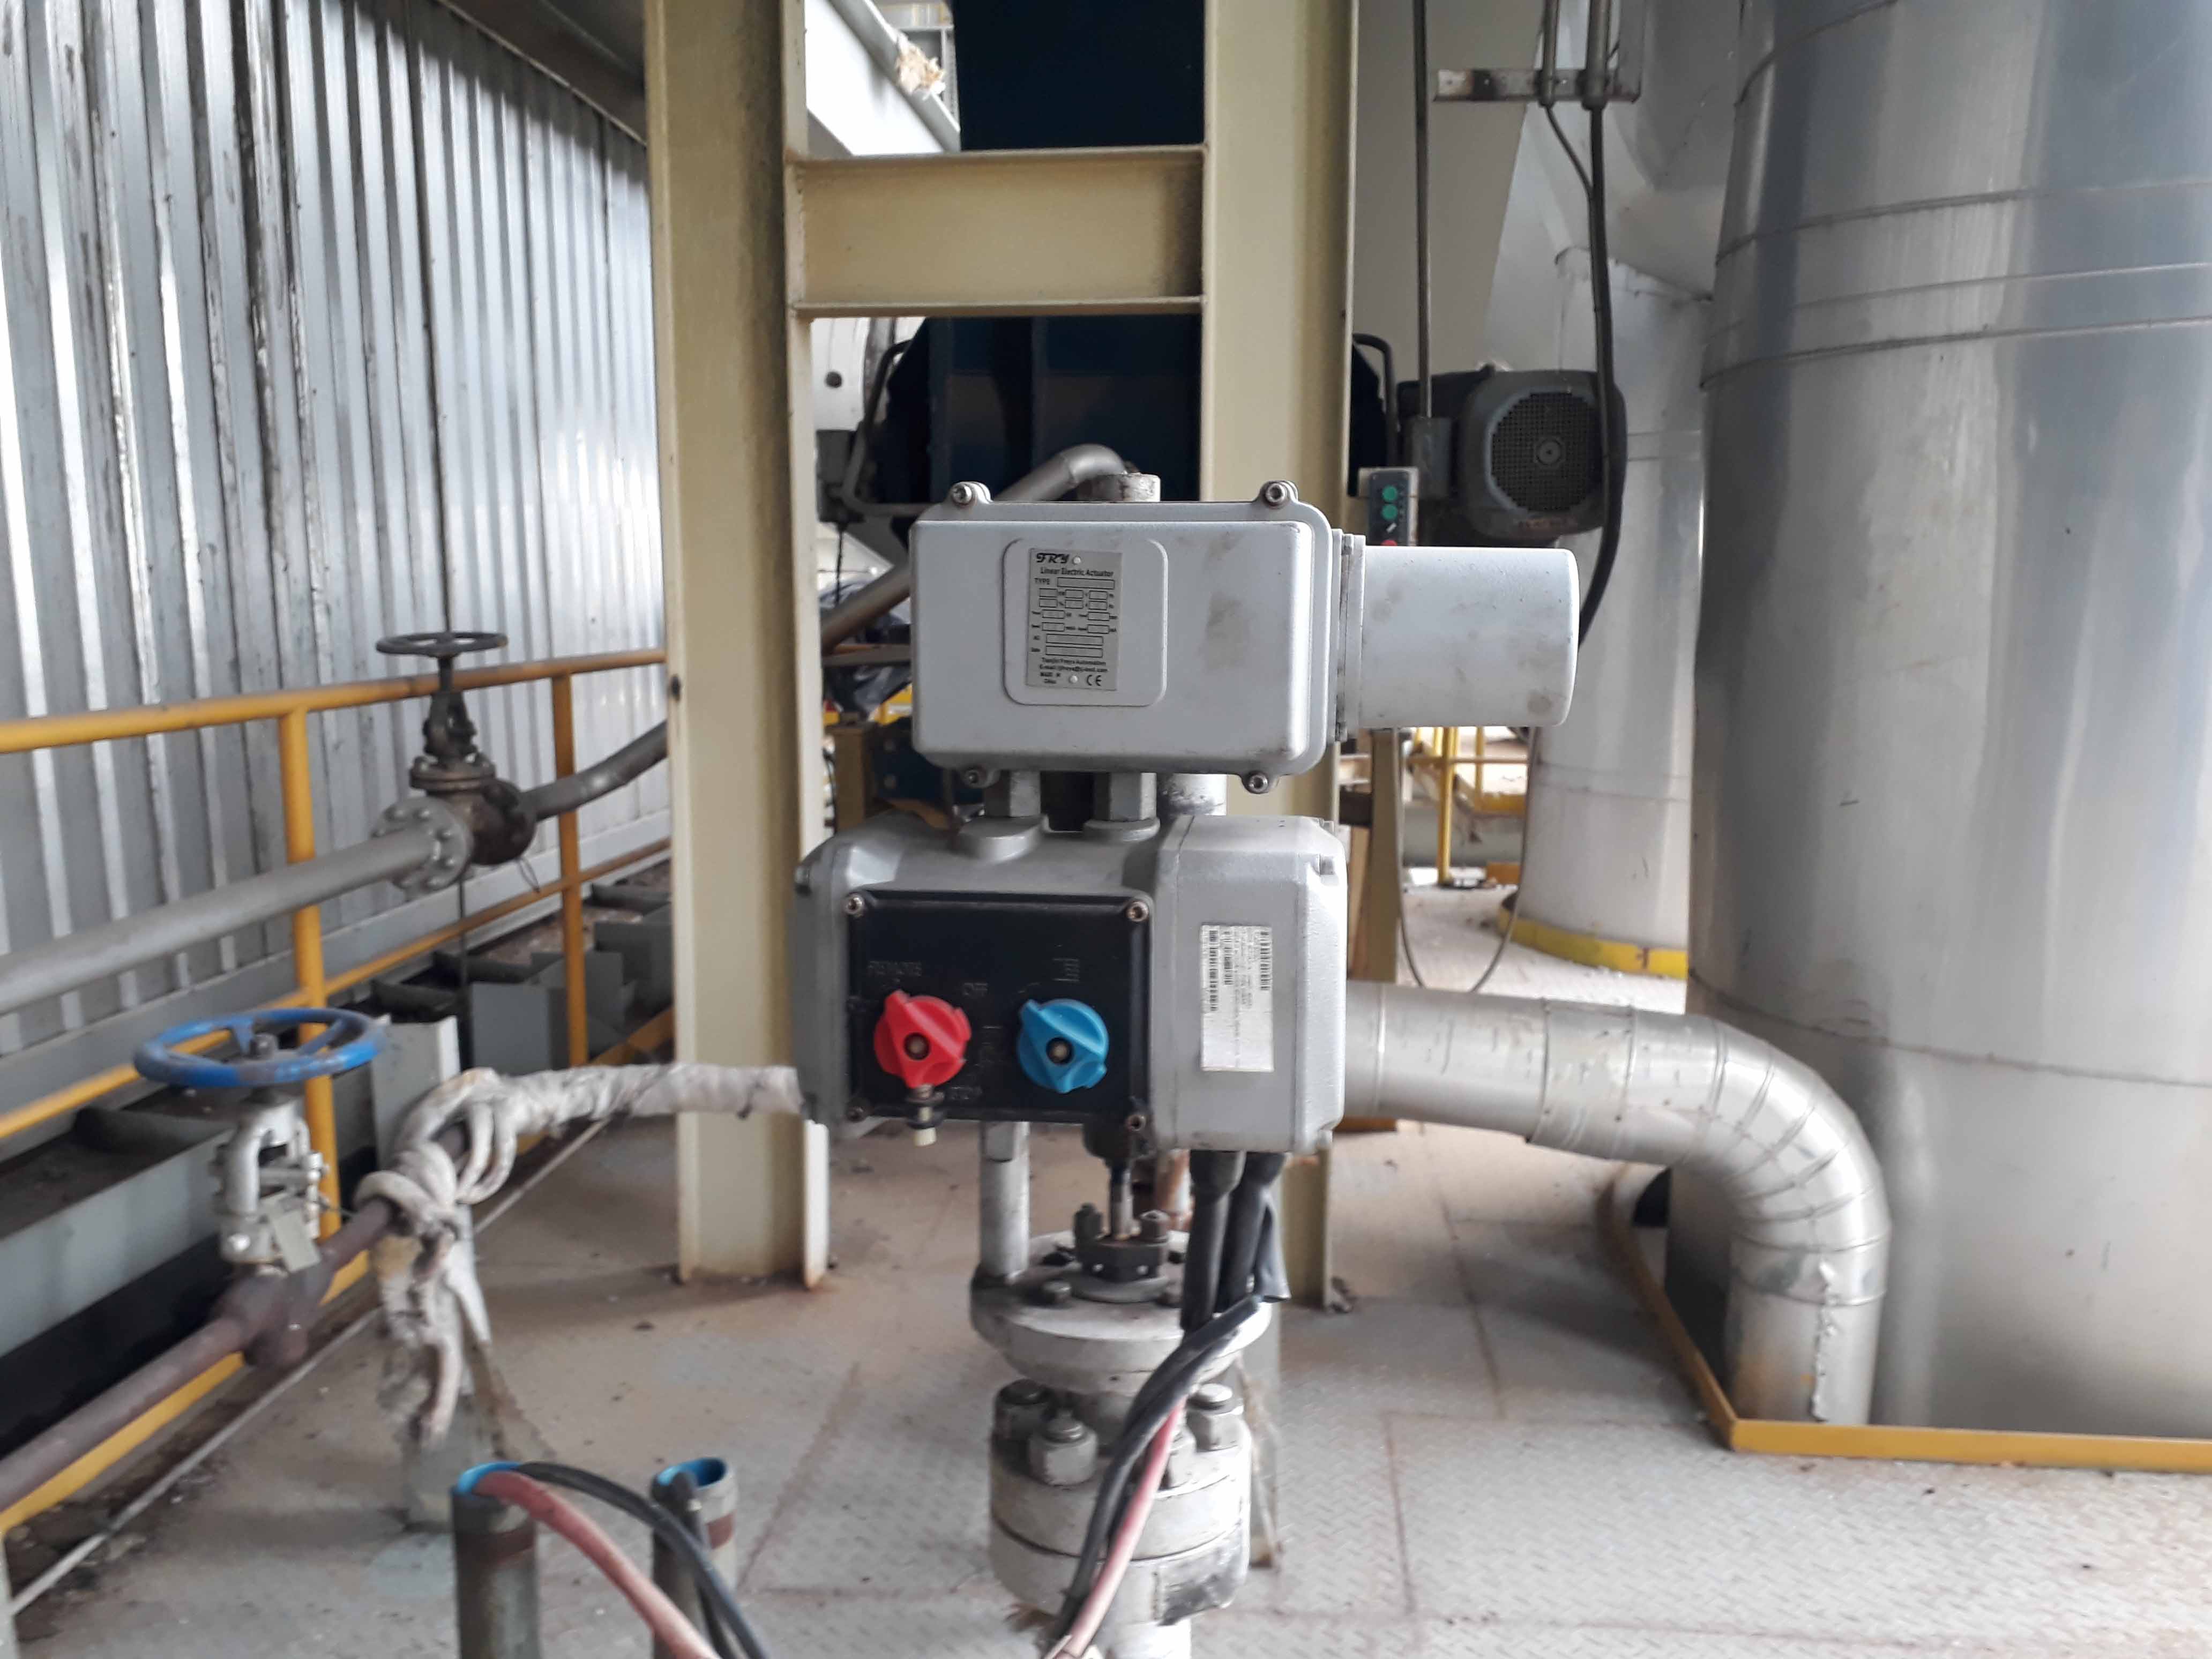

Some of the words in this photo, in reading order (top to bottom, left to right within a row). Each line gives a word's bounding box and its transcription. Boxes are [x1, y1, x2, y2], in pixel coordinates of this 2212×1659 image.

[1040, 566, 1060, 574] Linear
[1062, 567, 1085, 576] Electric
[1086, 569, 1114, 577] Actuator
